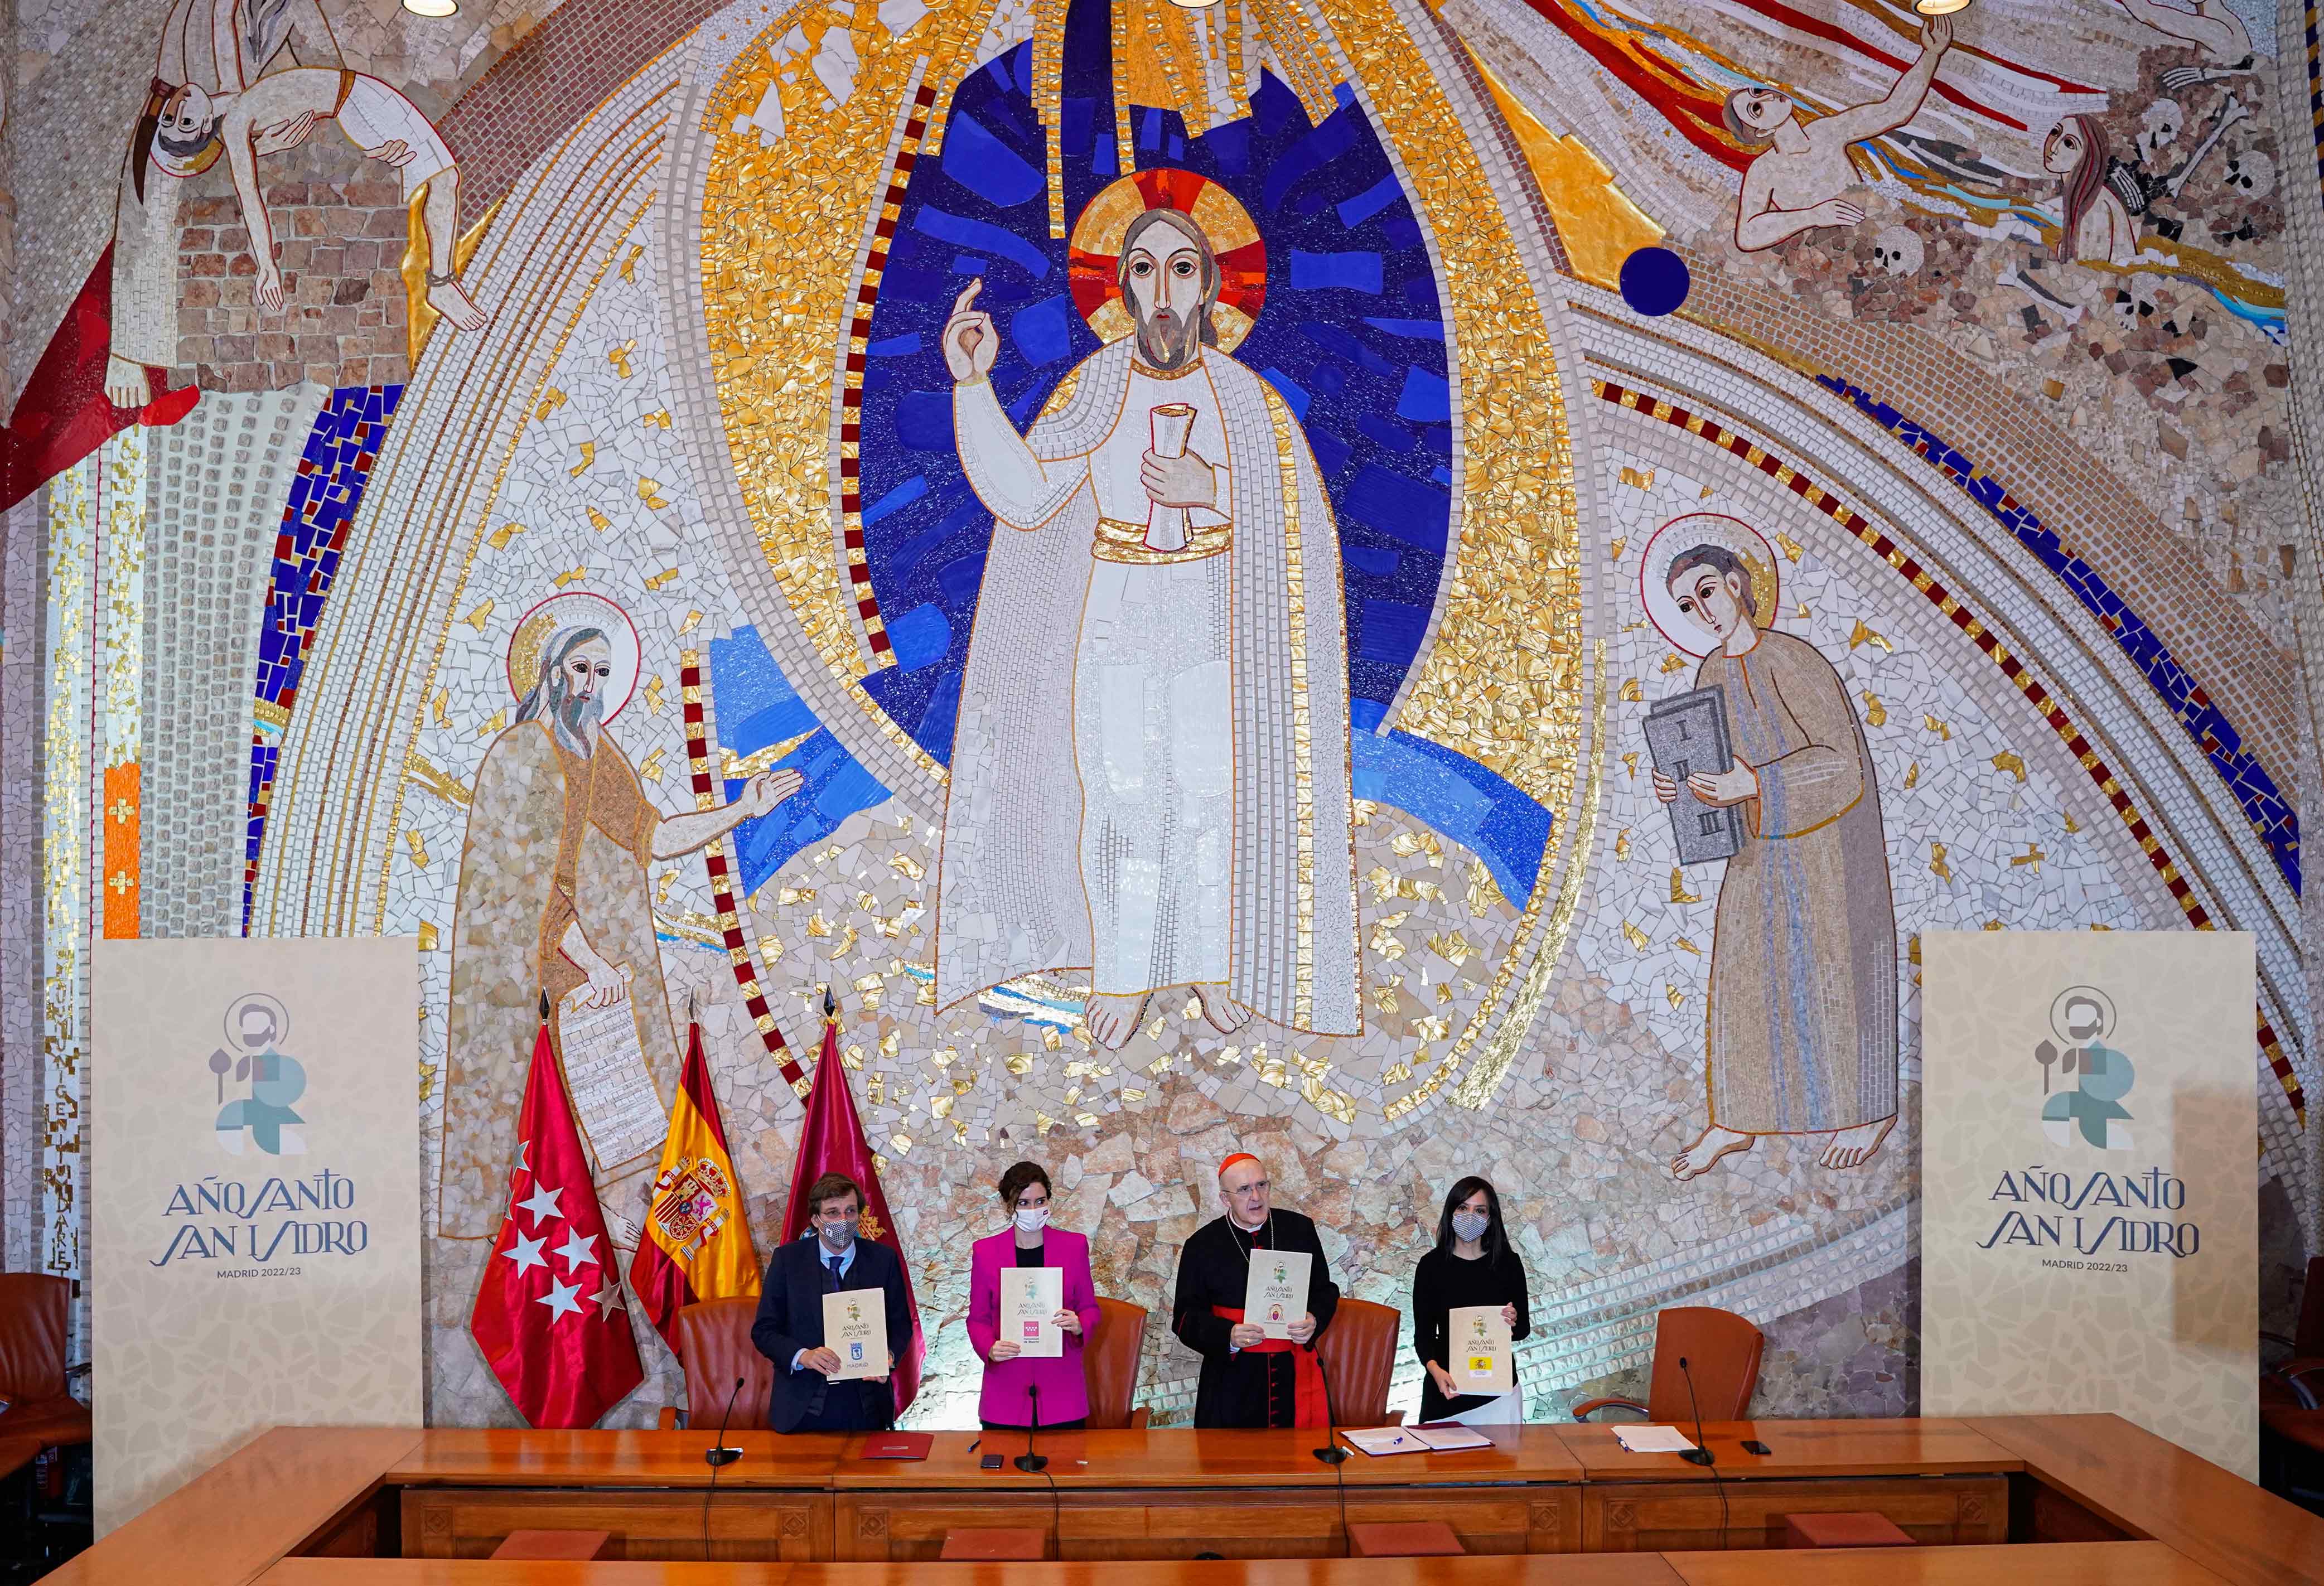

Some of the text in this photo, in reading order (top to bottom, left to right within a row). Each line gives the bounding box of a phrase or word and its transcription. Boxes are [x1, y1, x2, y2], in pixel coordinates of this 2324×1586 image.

[161, 1169, 354, 1219] AÑO SANTO
[1988, 1164, 2185, 1210] AÑO SANTO
[149, 1220, 368, 1266] SAN ISIDRO
[1975, 1211, 2199, 1258] SAN ISIDRO
[217, 1266, 302, 1279] MADRID 2022/23
[2042, 1259, 2128, 1273] MADRID 2022/23
